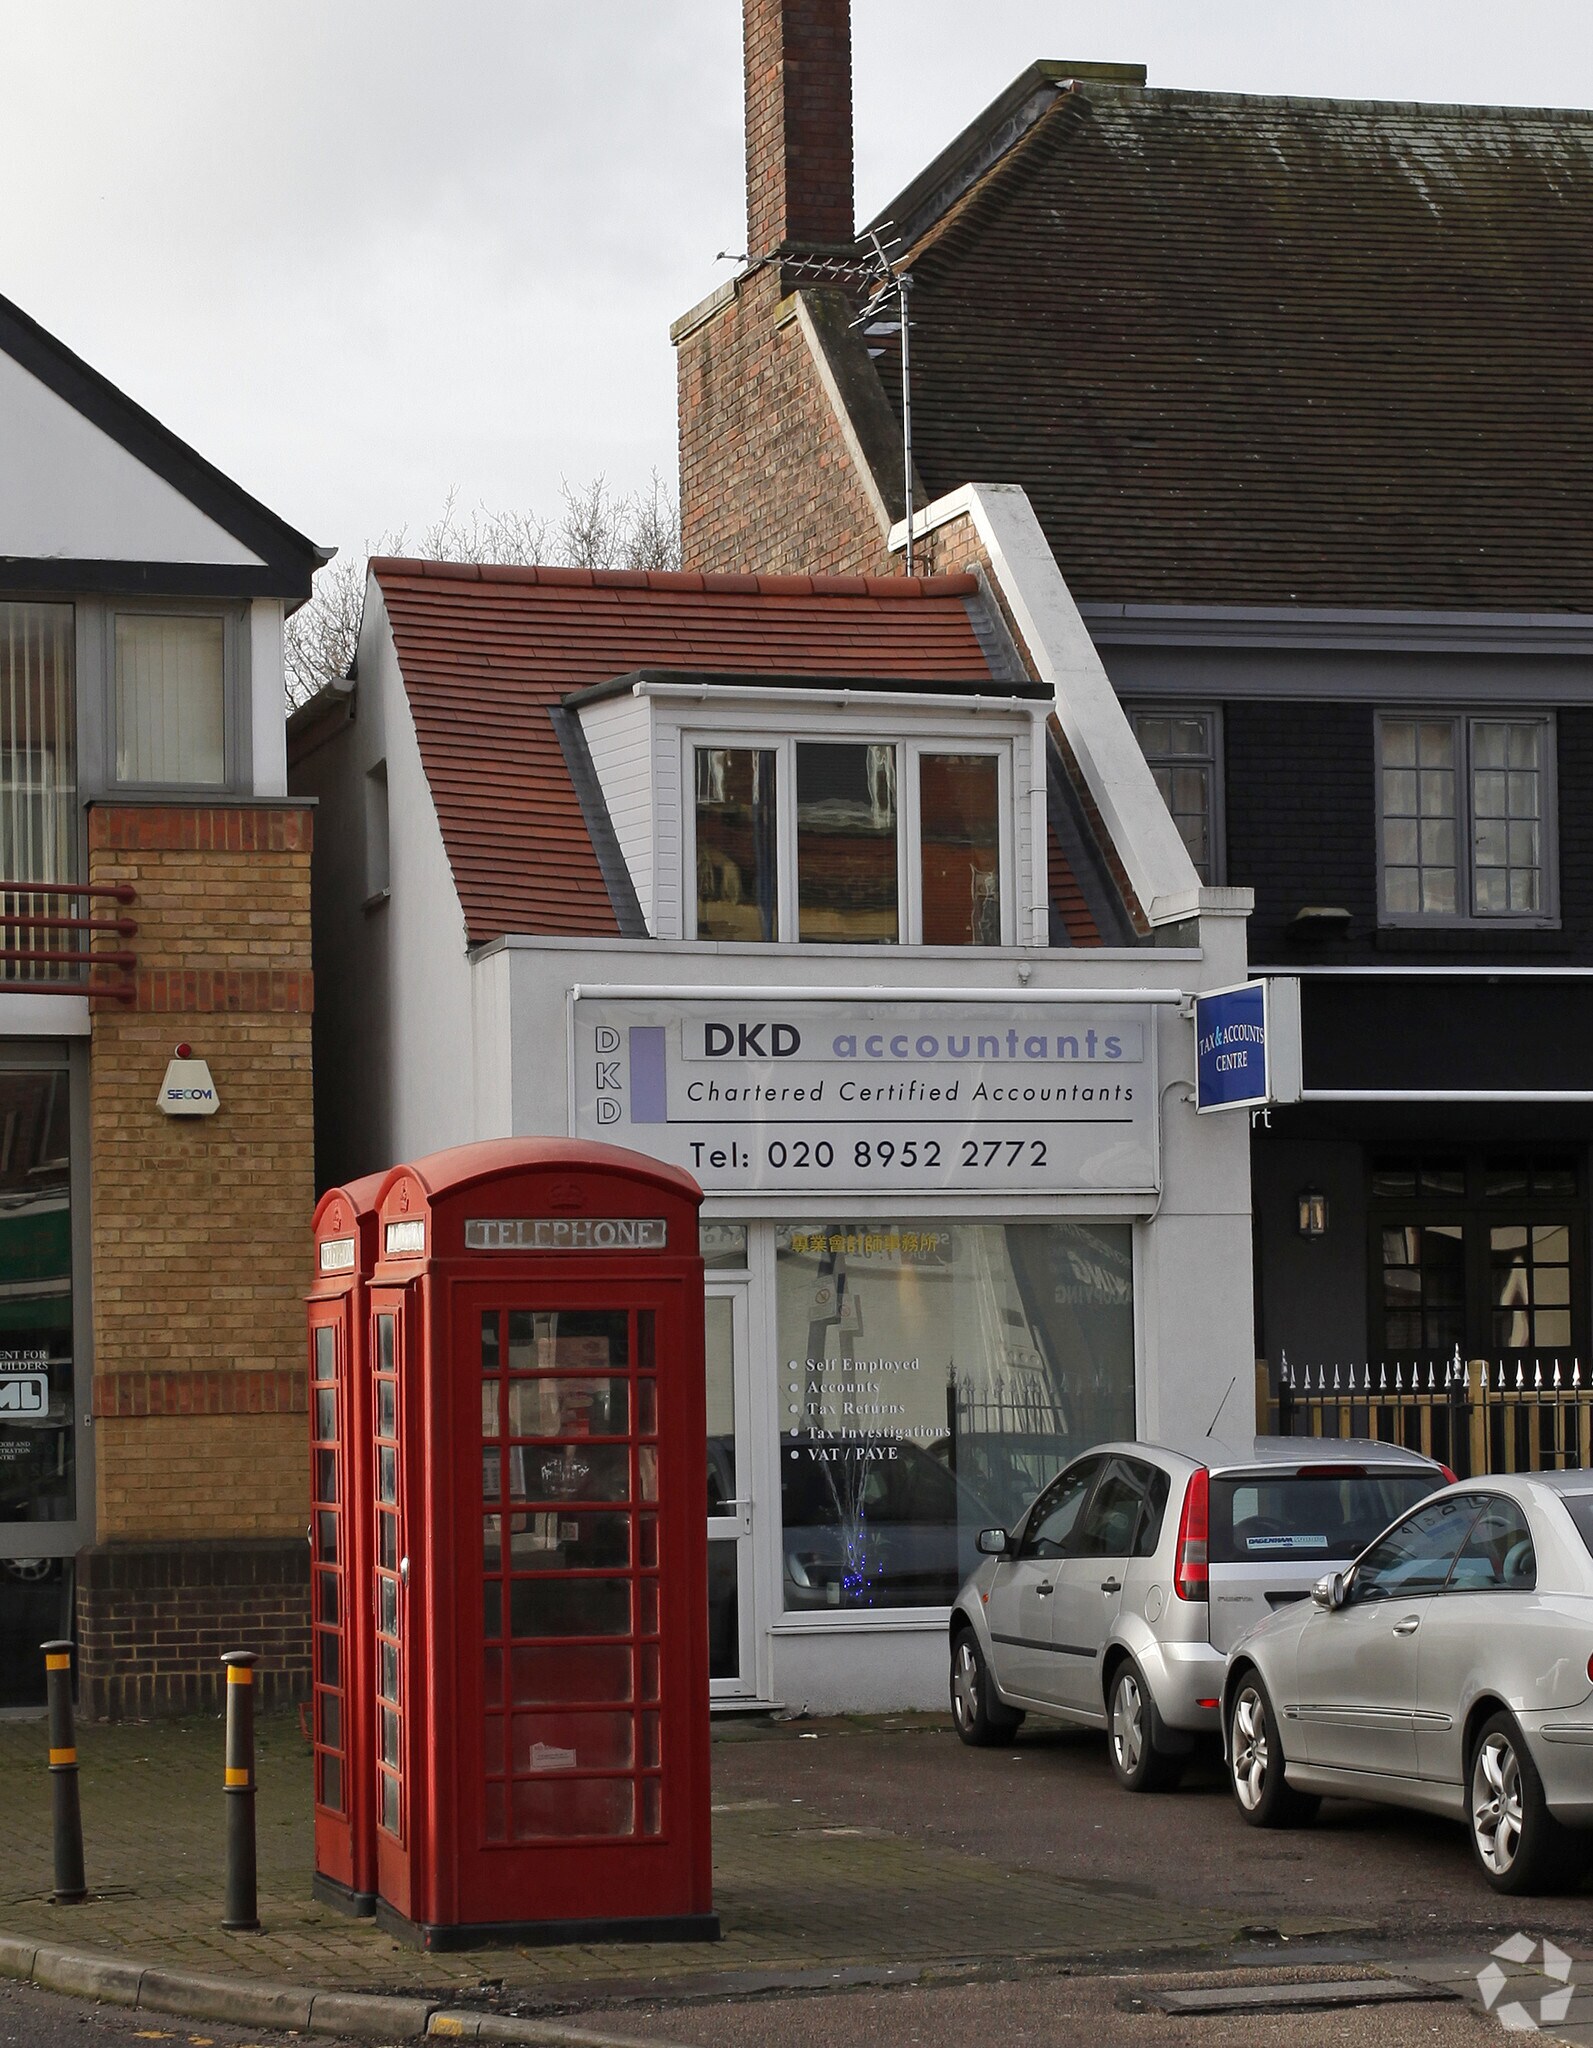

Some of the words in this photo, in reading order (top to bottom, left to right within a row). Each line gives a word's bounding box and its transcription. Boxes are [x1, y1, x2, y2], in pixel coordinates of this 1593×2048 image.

[704, 1023, 801, 1057] DKD
[832, 1029, 1123, 1058] accountants
[1200, 1033, 1215, 1056] TAX
[1223, 1024, 1265, 1044] ACCOUNTS
[1216, 1051, 1248, 1072] CENTRE
[167, 1089, 212, 1100] SECOM
[687, 1081, 824, 1101] Chartered
[839, 1079, 959, 1101] Certified
[972, 1082, 1133, 1101] Accountants
[1252, 1108, 1271, 1128] rt
[690, 1142, 749, 1168] Tel:
[768, 1141, 834, 1168] 020
[854, 1141, 941, 1168] 8952
[962, 1140, 1047, 1167] 2772
[477, 1222, 654, 1247] TELEPHONE
[23, 1350, 47, 1360] FOR
[805, 1358, 837, 1371] Self
[843, 1358, 920, 1374] Employed
[808, 1381, 880, 1393] Accounts
[807, 1402, 836, 1415] Tax
[844, 1402, 905, 1415] Returns
[807, 1426, 834, 1439] Tax
[842, 1425, 951, 1440] Investigations
[808, 1448, 839, 1460] VAT
[856, 1447, 898, 1460] PAYE
